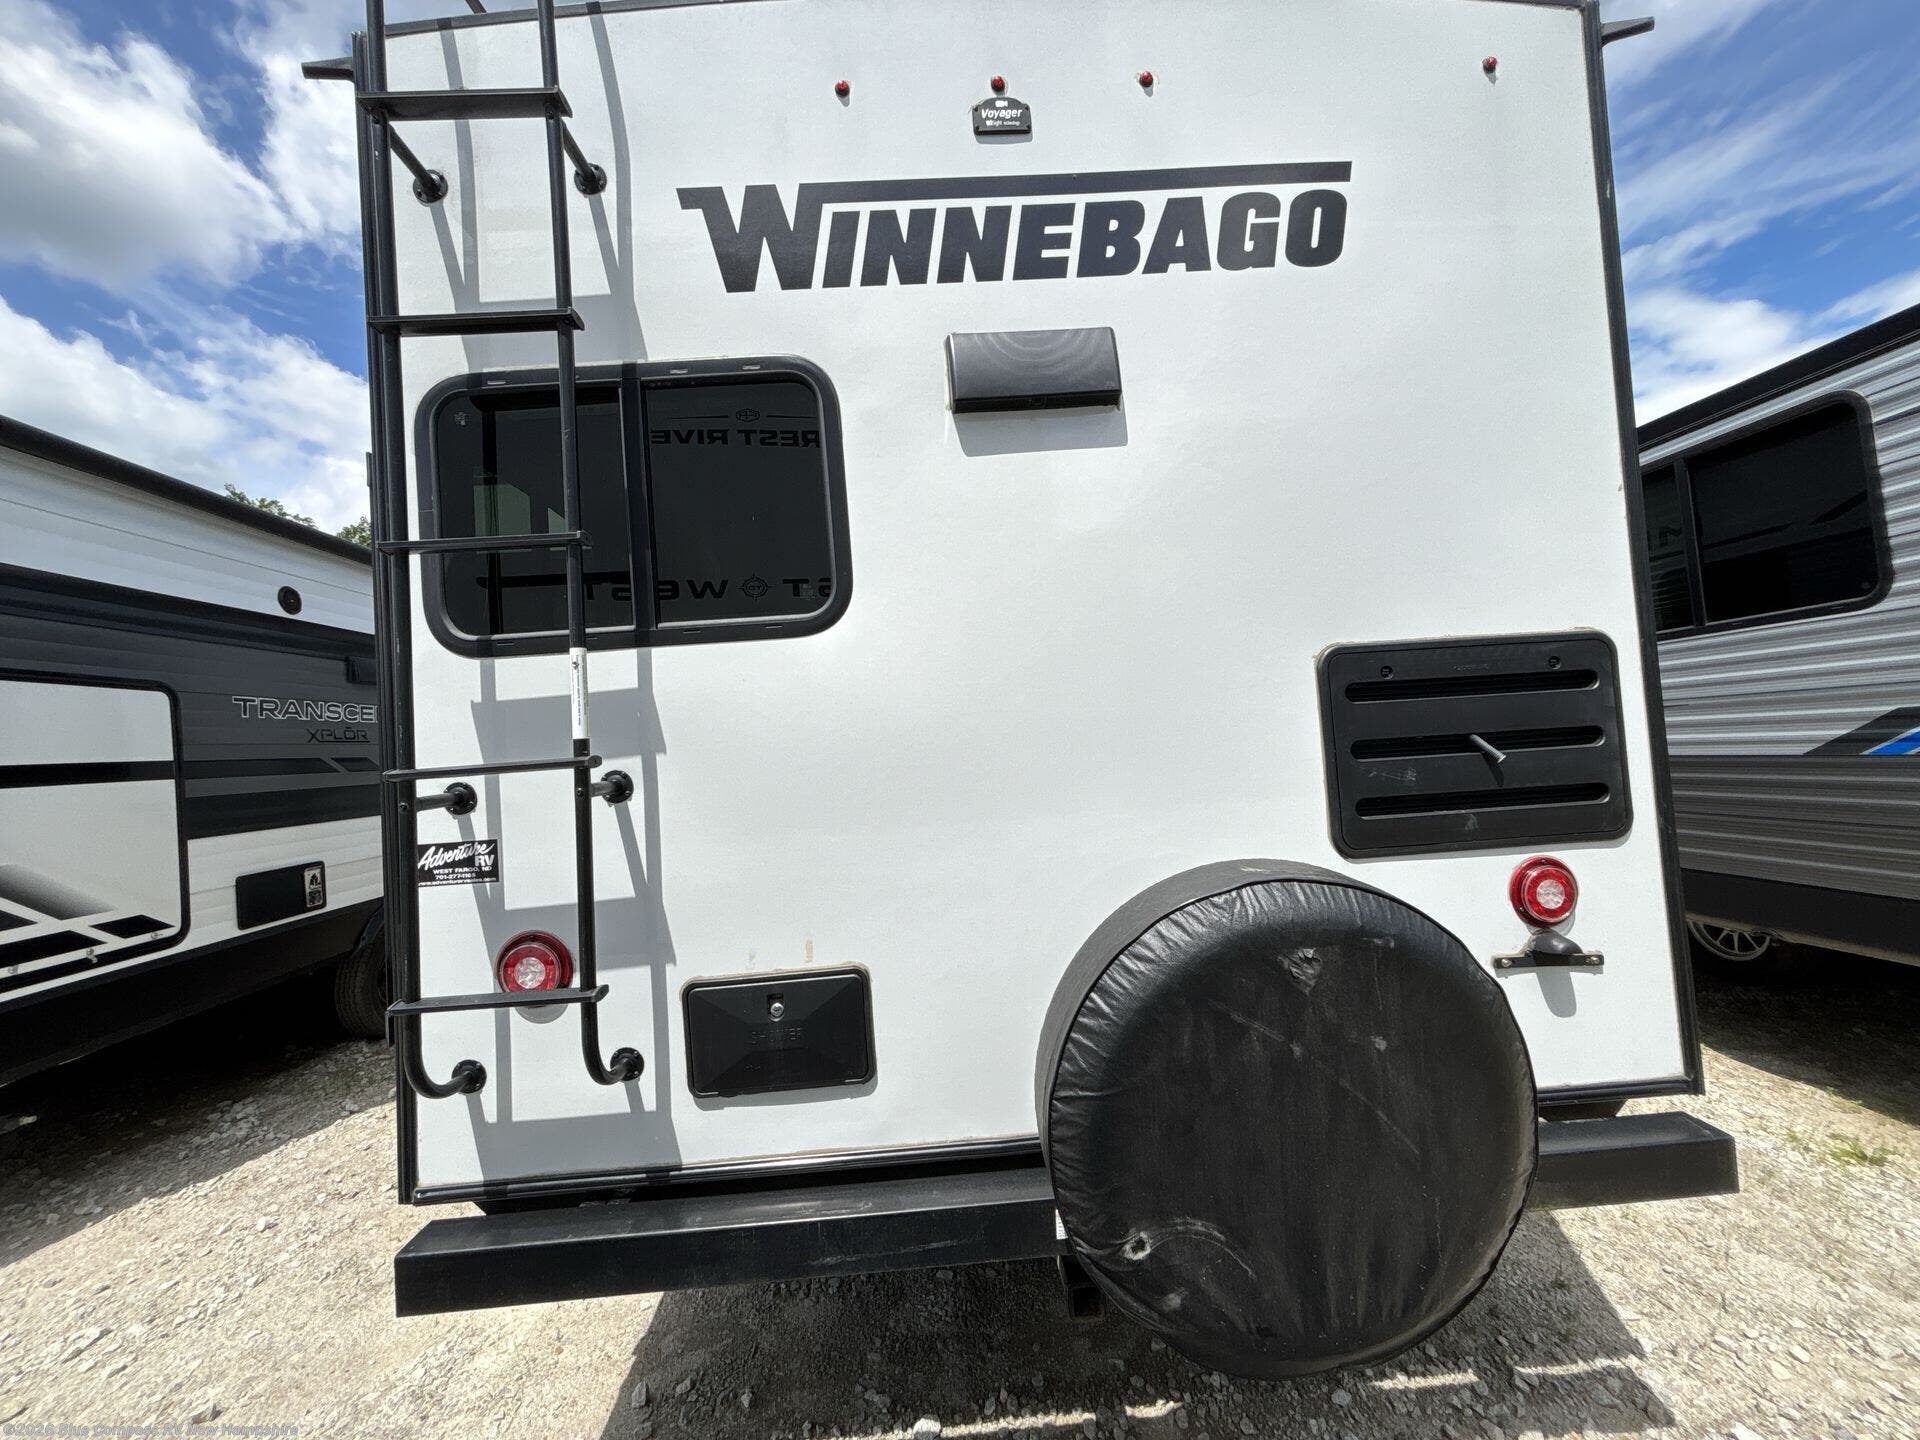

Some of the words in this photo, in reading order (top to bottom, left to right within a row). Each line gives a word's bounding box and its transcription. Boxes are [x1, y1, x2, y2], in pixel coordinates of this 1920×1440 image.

[981, 108, 1023, 119] Voyager
[676, 161, 1352, 293] WINNEBAGO
[231, 695, 379, 724] TRANSCE
[417, 842, 495, 871] Adventure
[474, 854, 495, 867] RV
[432, 867, 453, 875] WEST
